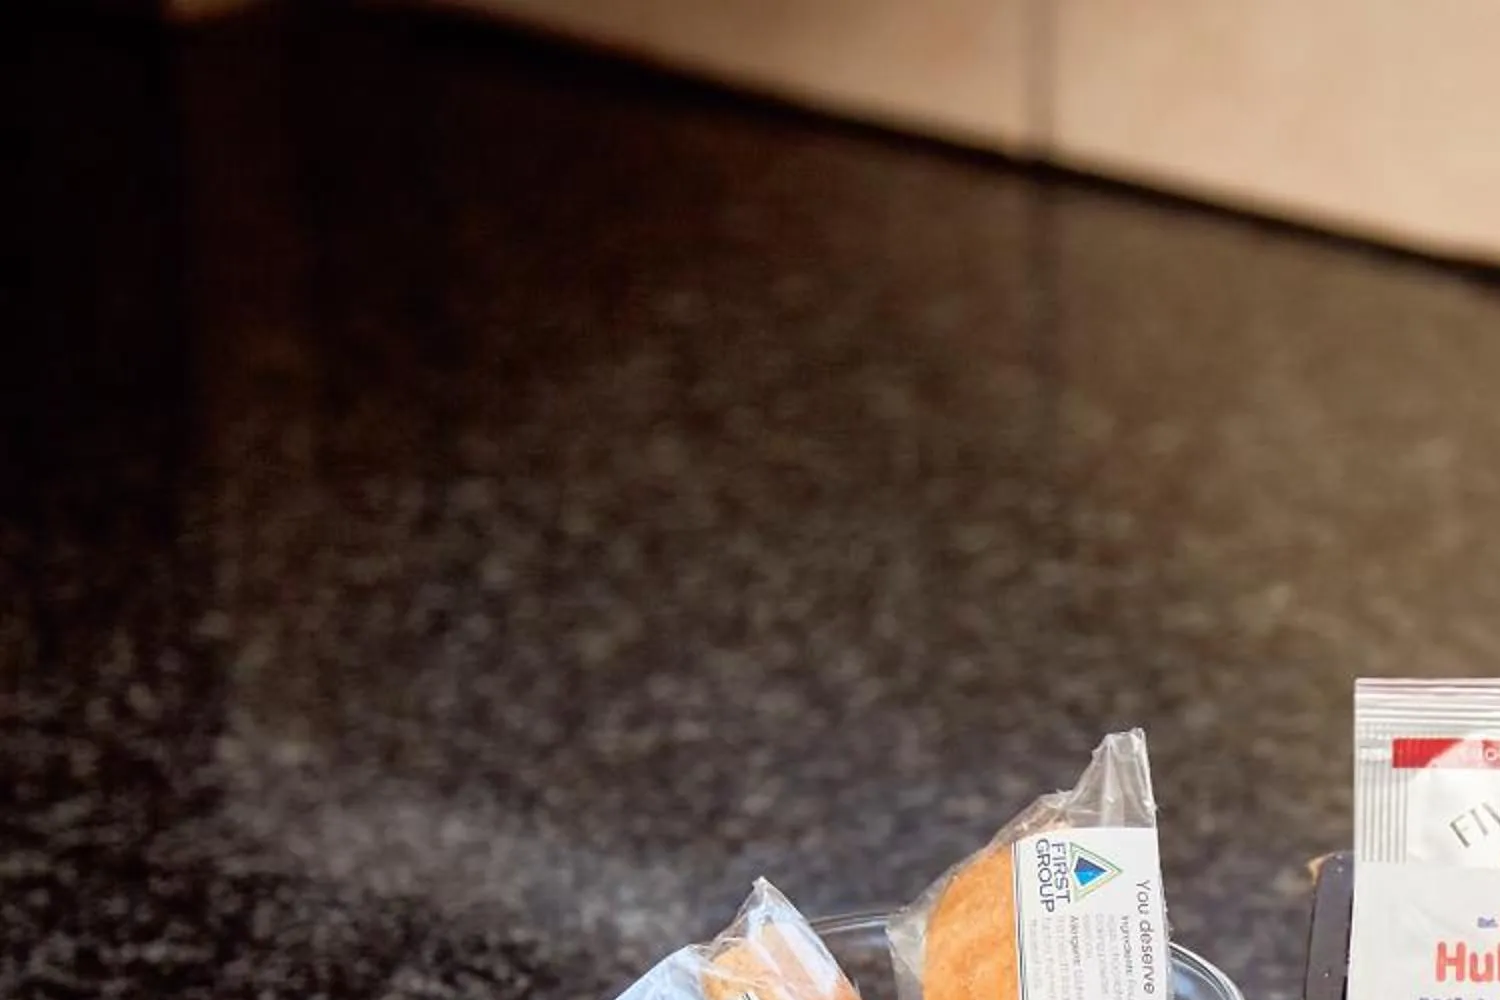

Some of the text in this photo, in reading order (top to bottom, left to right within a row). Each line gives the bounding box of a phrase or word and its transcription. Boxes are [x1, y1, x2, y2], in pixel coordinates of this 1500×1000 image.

[1036, 837, 1056, 913] GROUP
[1051, 841, 1072, 905] FIRST
[1136, 879, 1151, 915] You
[1138, 920, 1156, 995] deserve
